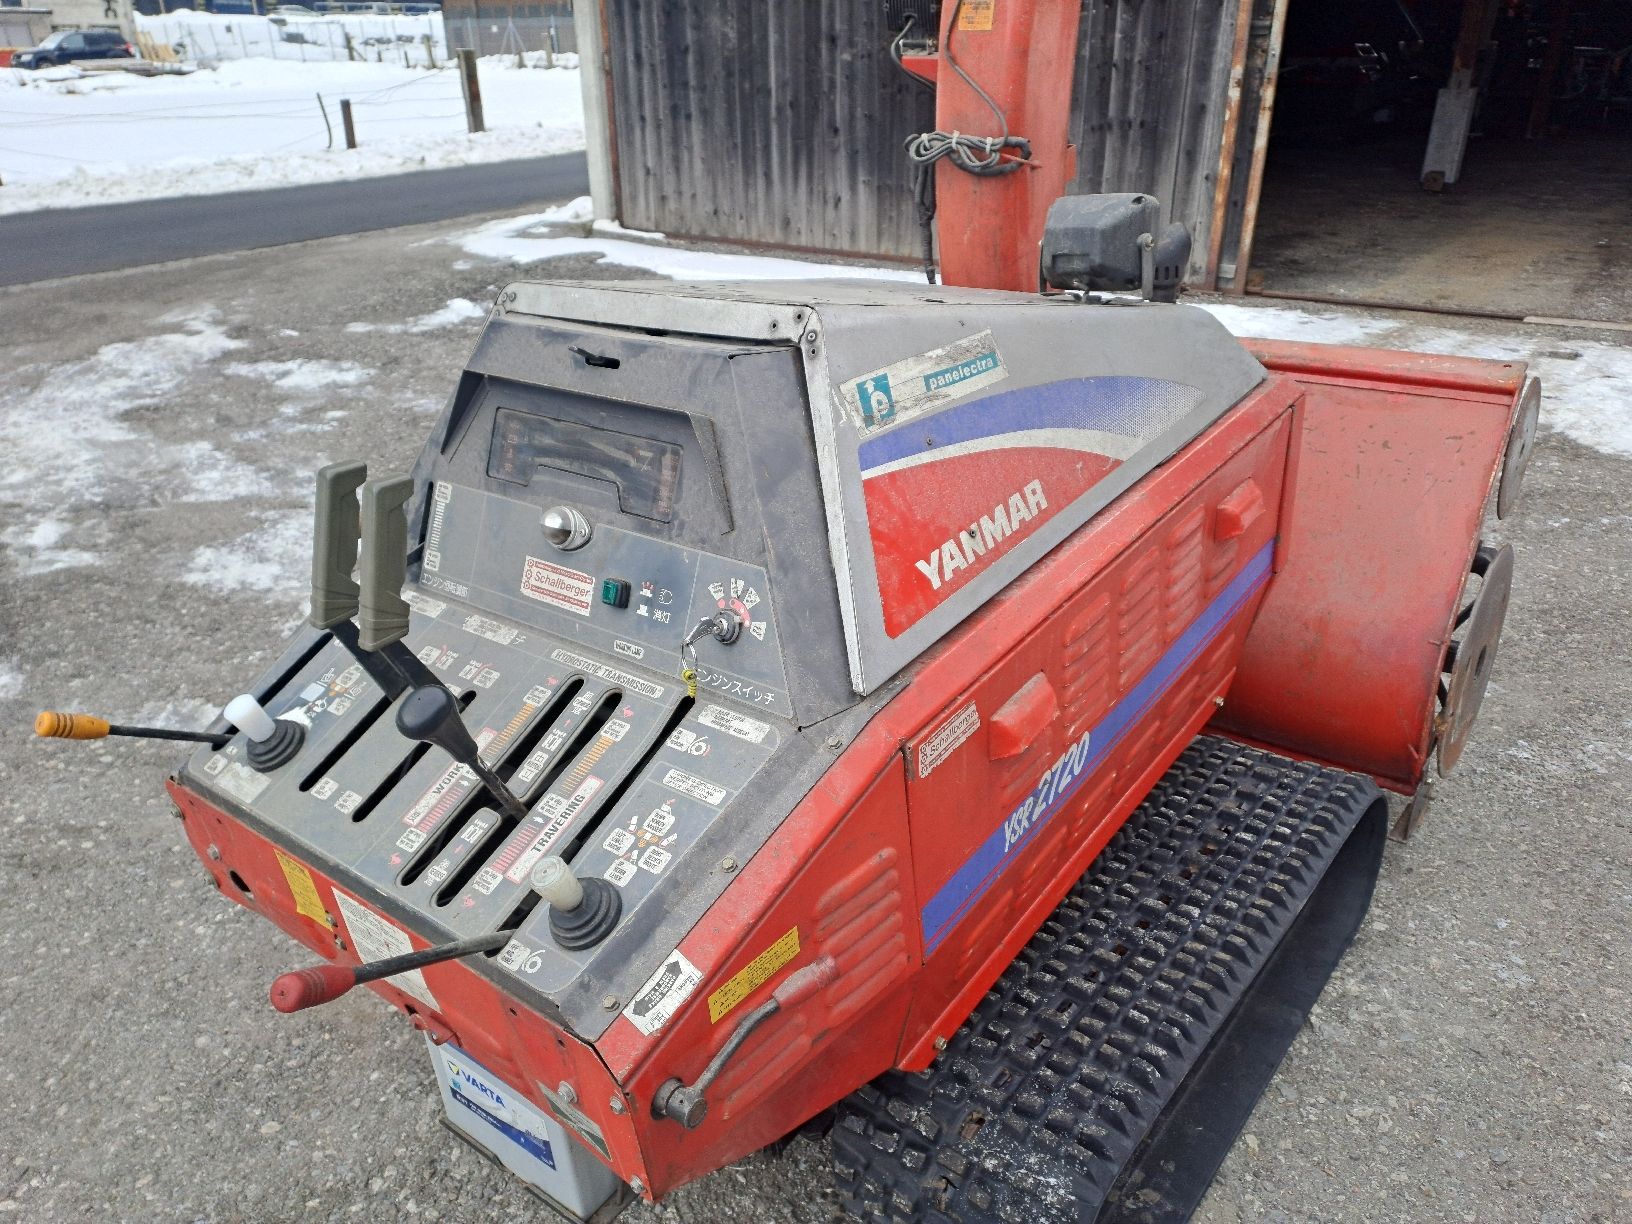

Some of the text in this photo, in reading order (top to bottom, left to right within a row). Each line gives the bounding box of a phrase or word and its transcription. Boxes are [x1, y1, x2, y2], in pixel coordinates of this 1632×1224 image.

[929, 357, 994, 391] panelectra
[914, 479, 1049, 590] YANMAR
[554, 649, 602, 677] HYDROSTATIC
[601, 665, 659, 697] TRANSMISSION
[929, 709, 977, 757] Schallberger
[431, 762, 465, 796] WORK
[530, 794, 586, 853] TRAVERING
[461, 1069, 506, 1108] VARTA
